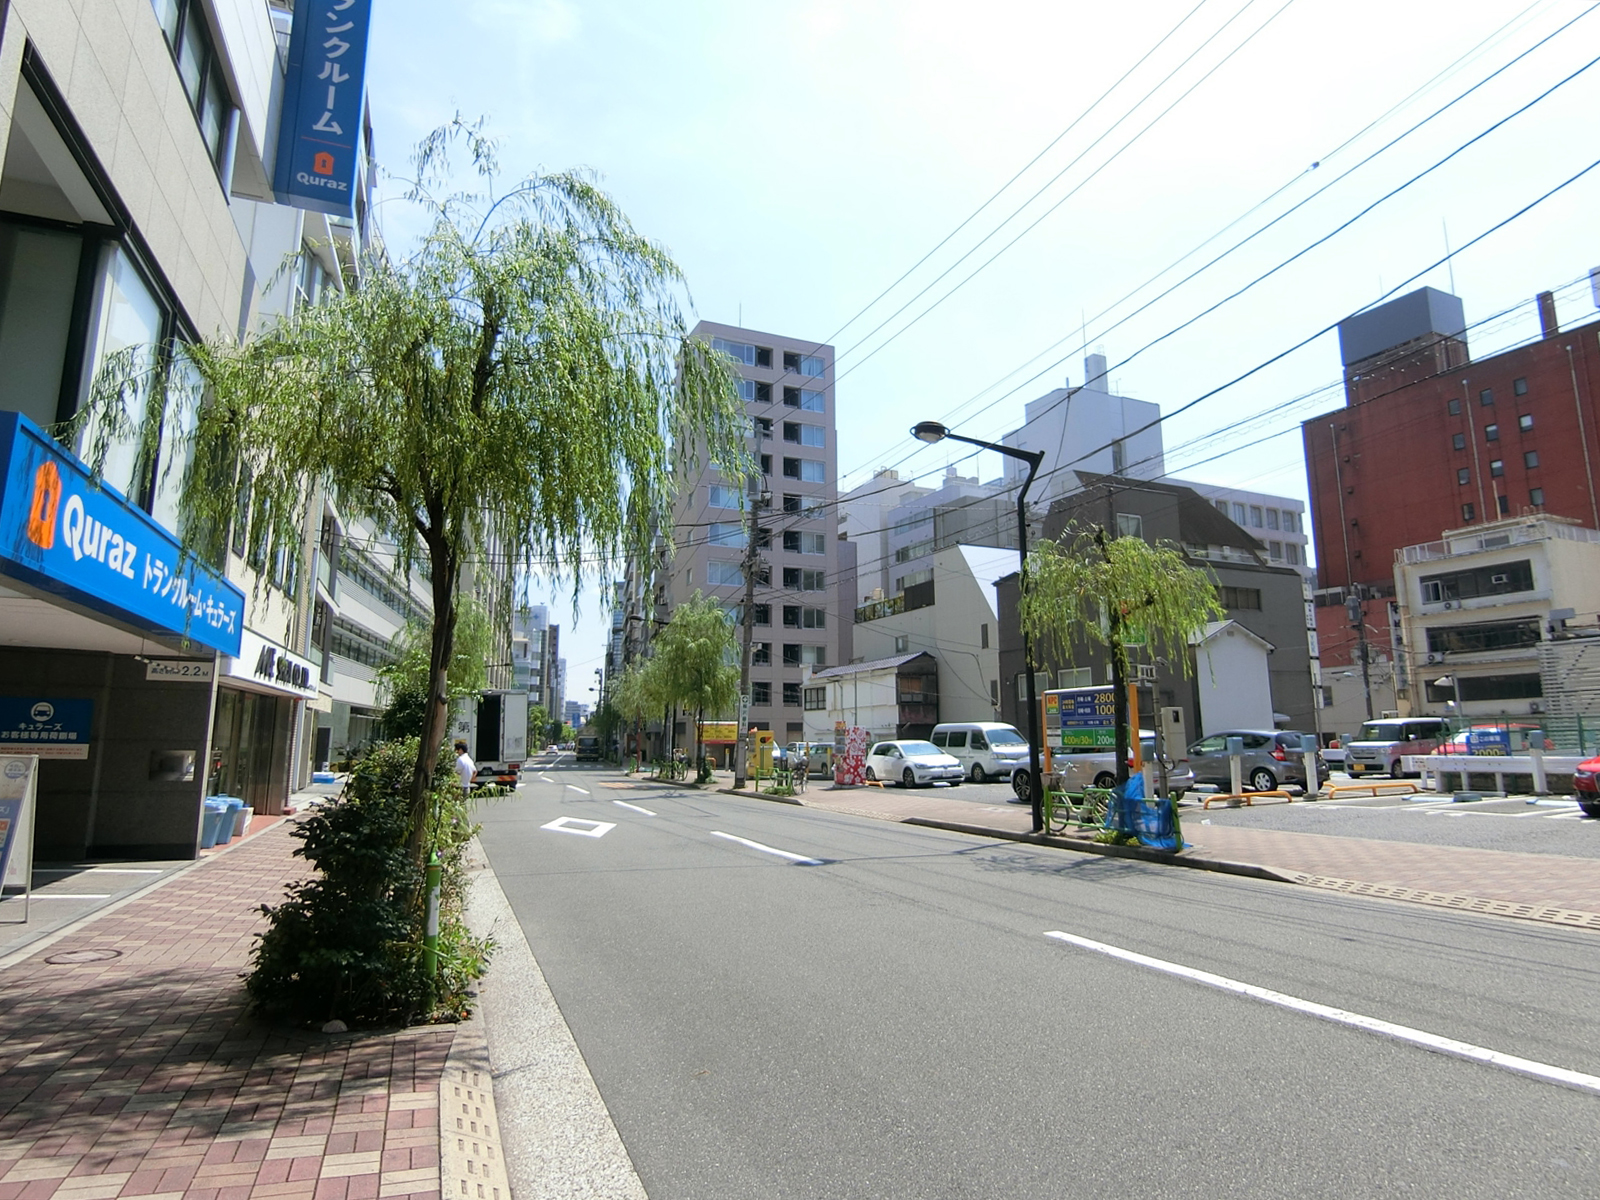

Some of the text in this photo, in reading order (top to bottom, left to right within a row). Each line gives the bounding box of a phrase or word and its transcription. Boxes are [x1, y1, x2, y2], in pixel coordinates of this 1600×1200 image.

[296, 172, 348, 192] Quraz
[63, 494, 137, 580] Quraz
[18, 722, 63, 731] キュラーズ
